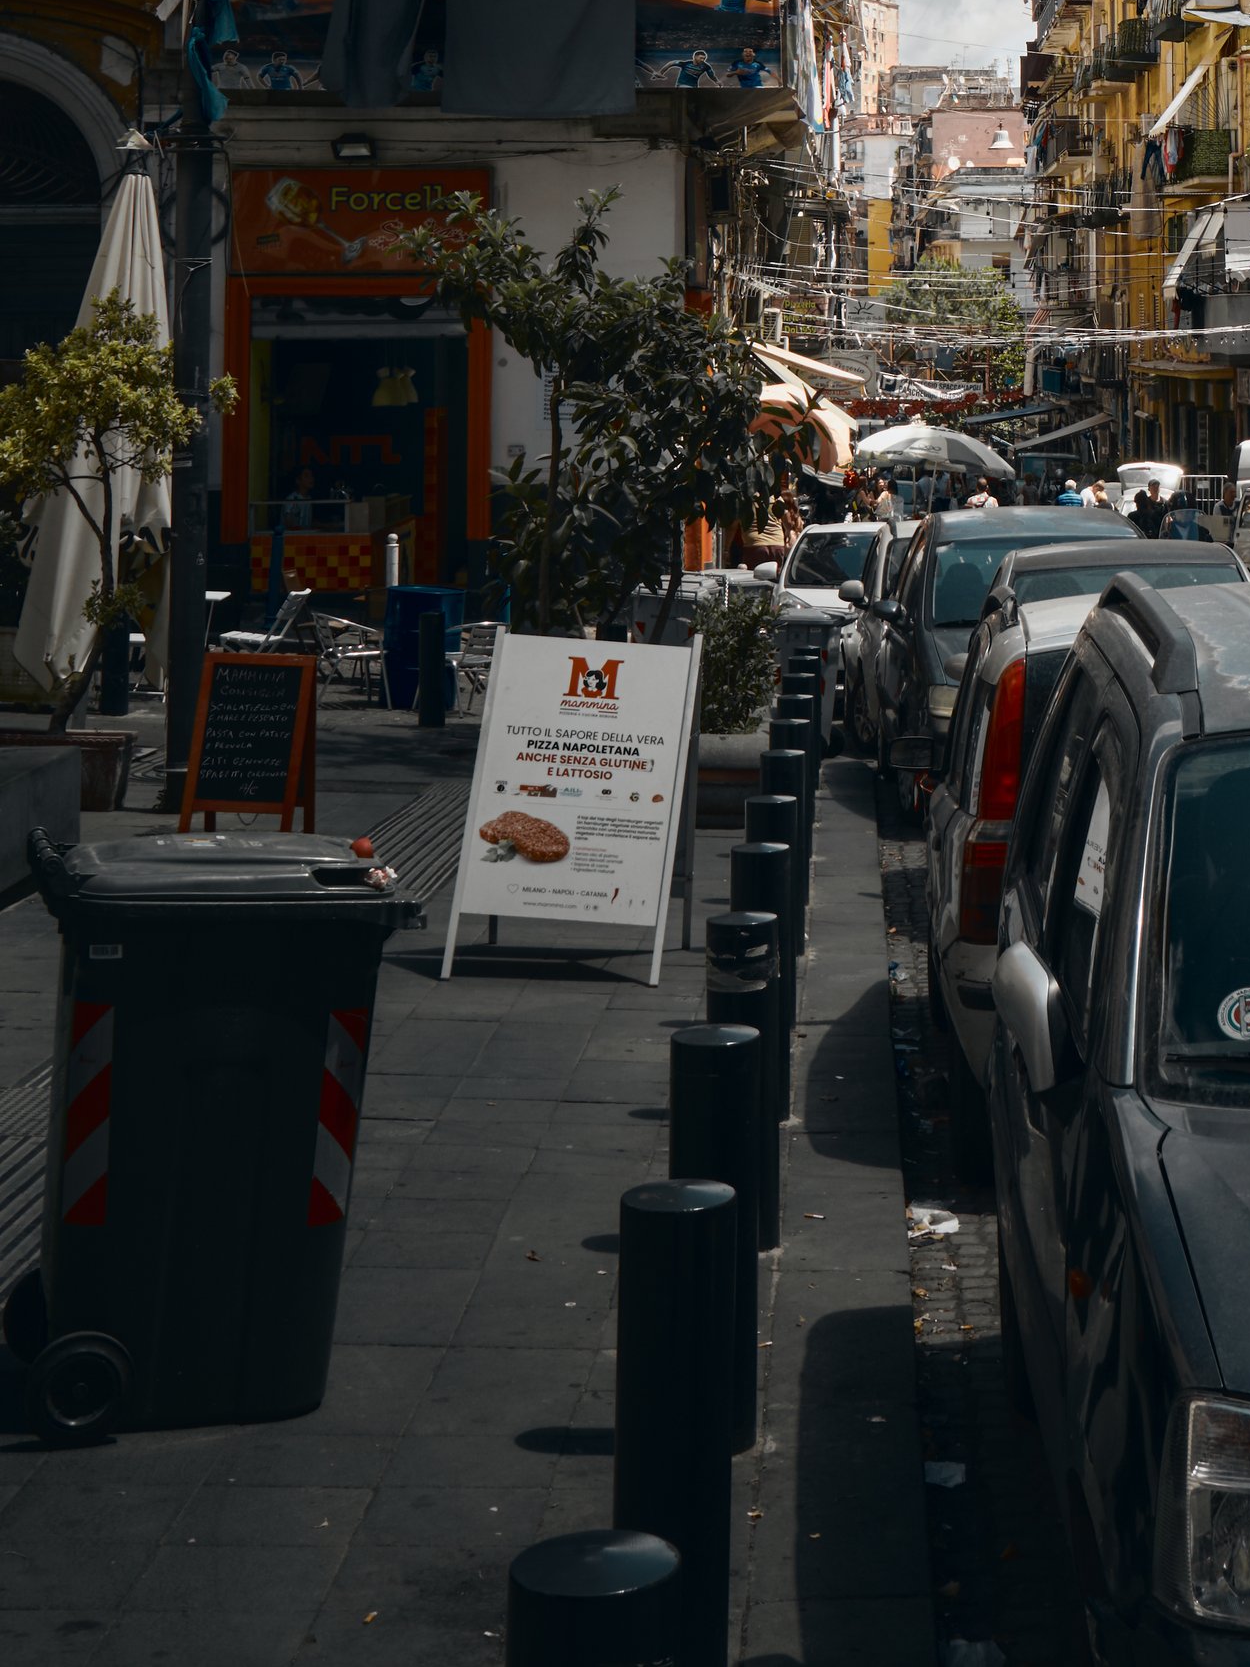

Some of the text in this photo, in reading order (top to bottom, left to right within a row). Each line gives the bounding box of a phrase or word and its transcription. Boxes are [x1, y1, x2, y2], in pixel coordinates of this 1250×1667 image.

[560, 699, 619, 711] mammina
[507, 725, 664, 745] TUTTO IL SAPORE DELLA VERA
[527, 739, 640, 757] PIZZA NAPOLETANA
[516, 751, 647, 770] ANCHE SENZA GLUTINE
[547, 767, 612, 780] E LATTOSIO
[522, 886, 546, 894] MILANO
[580, 890, 608, 898] CATANIA
